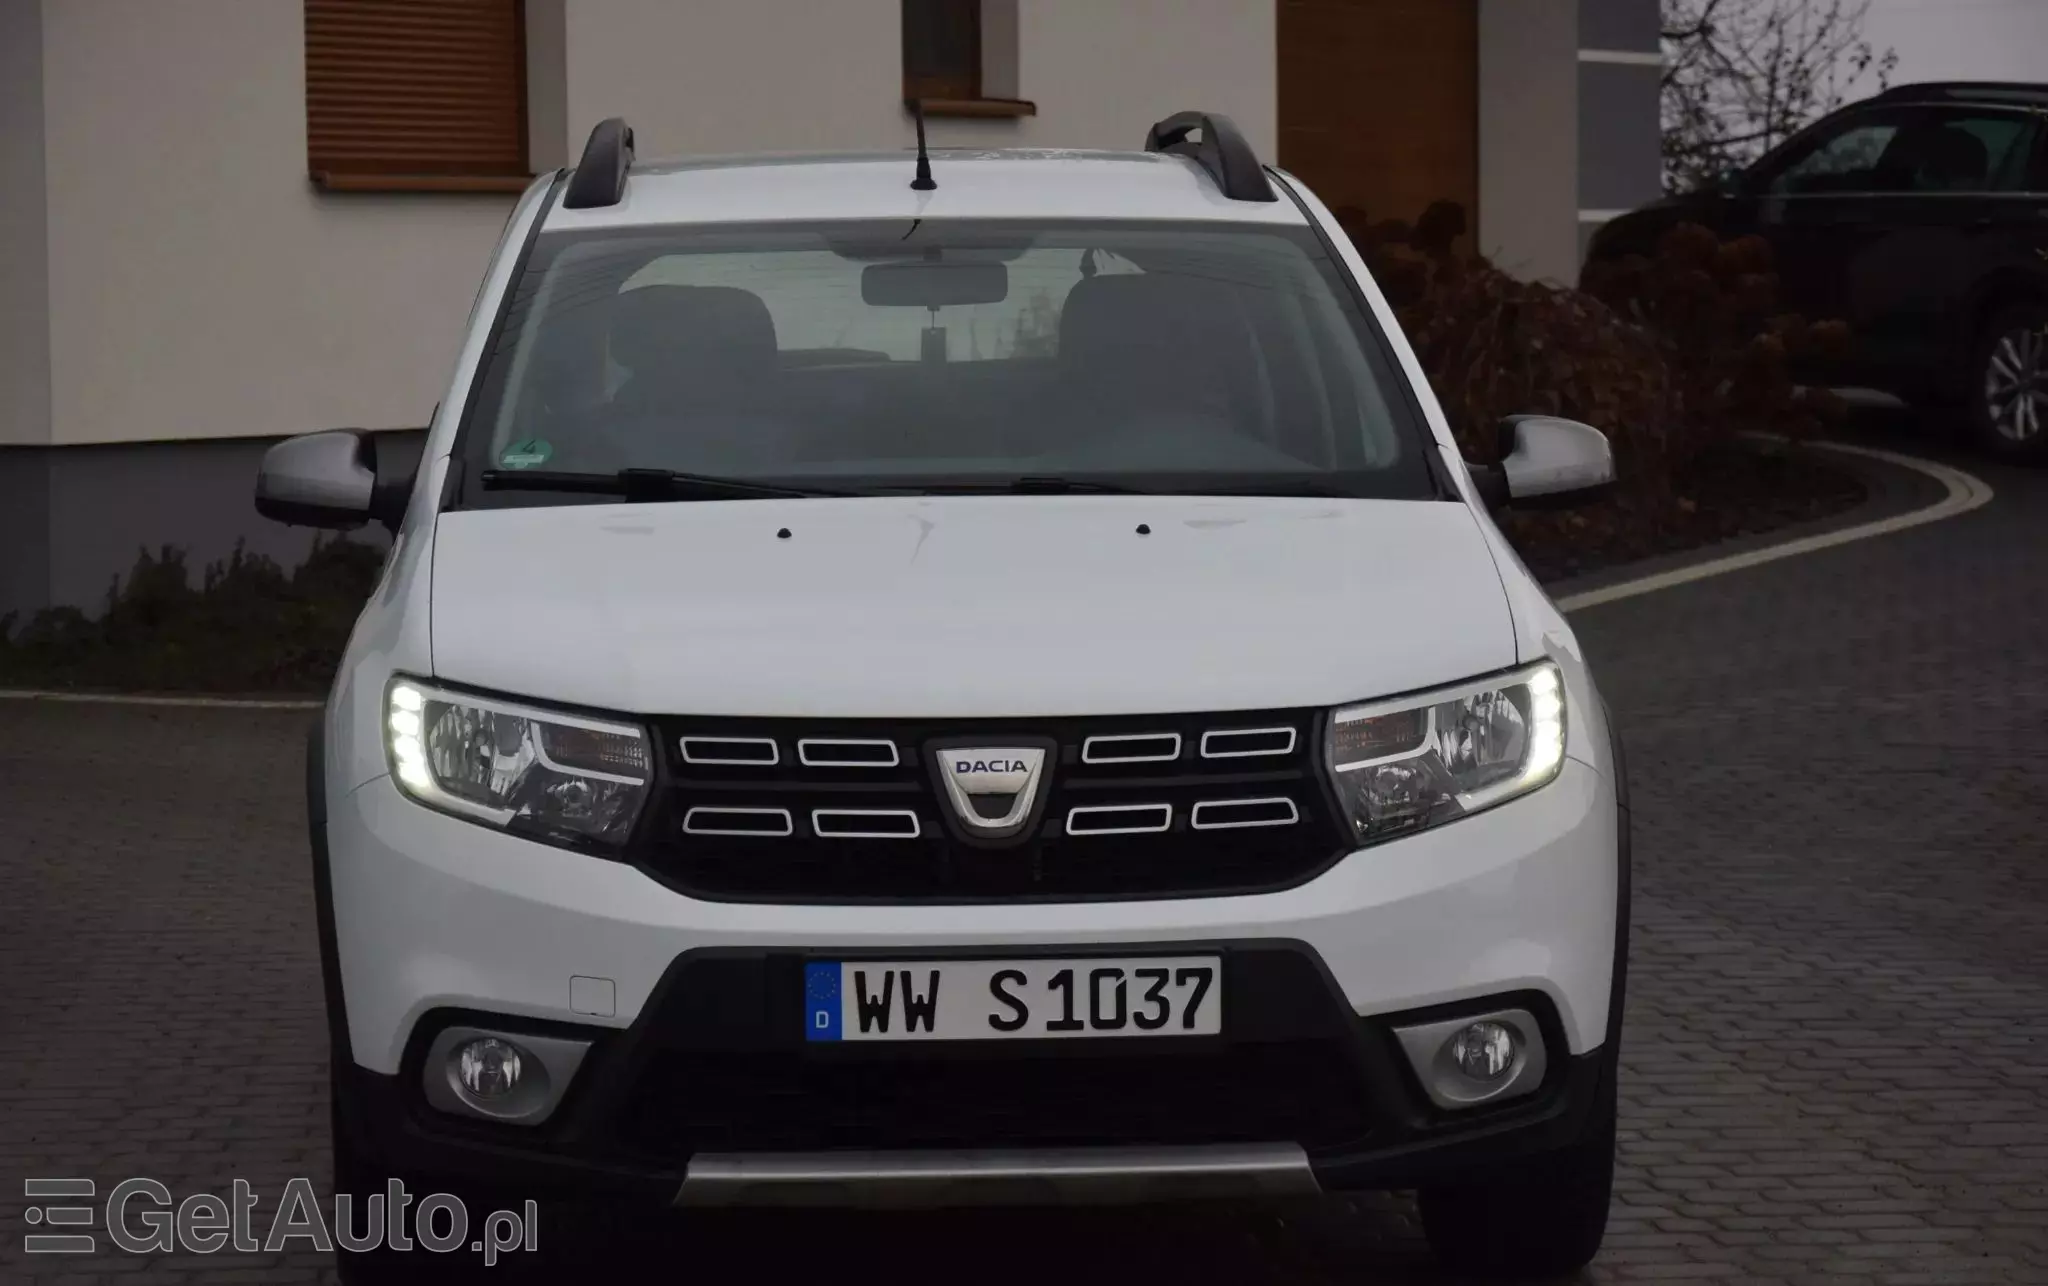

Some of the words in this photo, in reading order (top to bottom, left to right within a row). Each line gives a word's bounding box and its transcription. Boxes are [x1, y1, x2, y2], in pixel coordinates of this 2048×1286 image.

[955, 760, 1028, 773] DACIA
[854, 970, 940, 1033] WW
[815, 1011, 829, 1029] D
